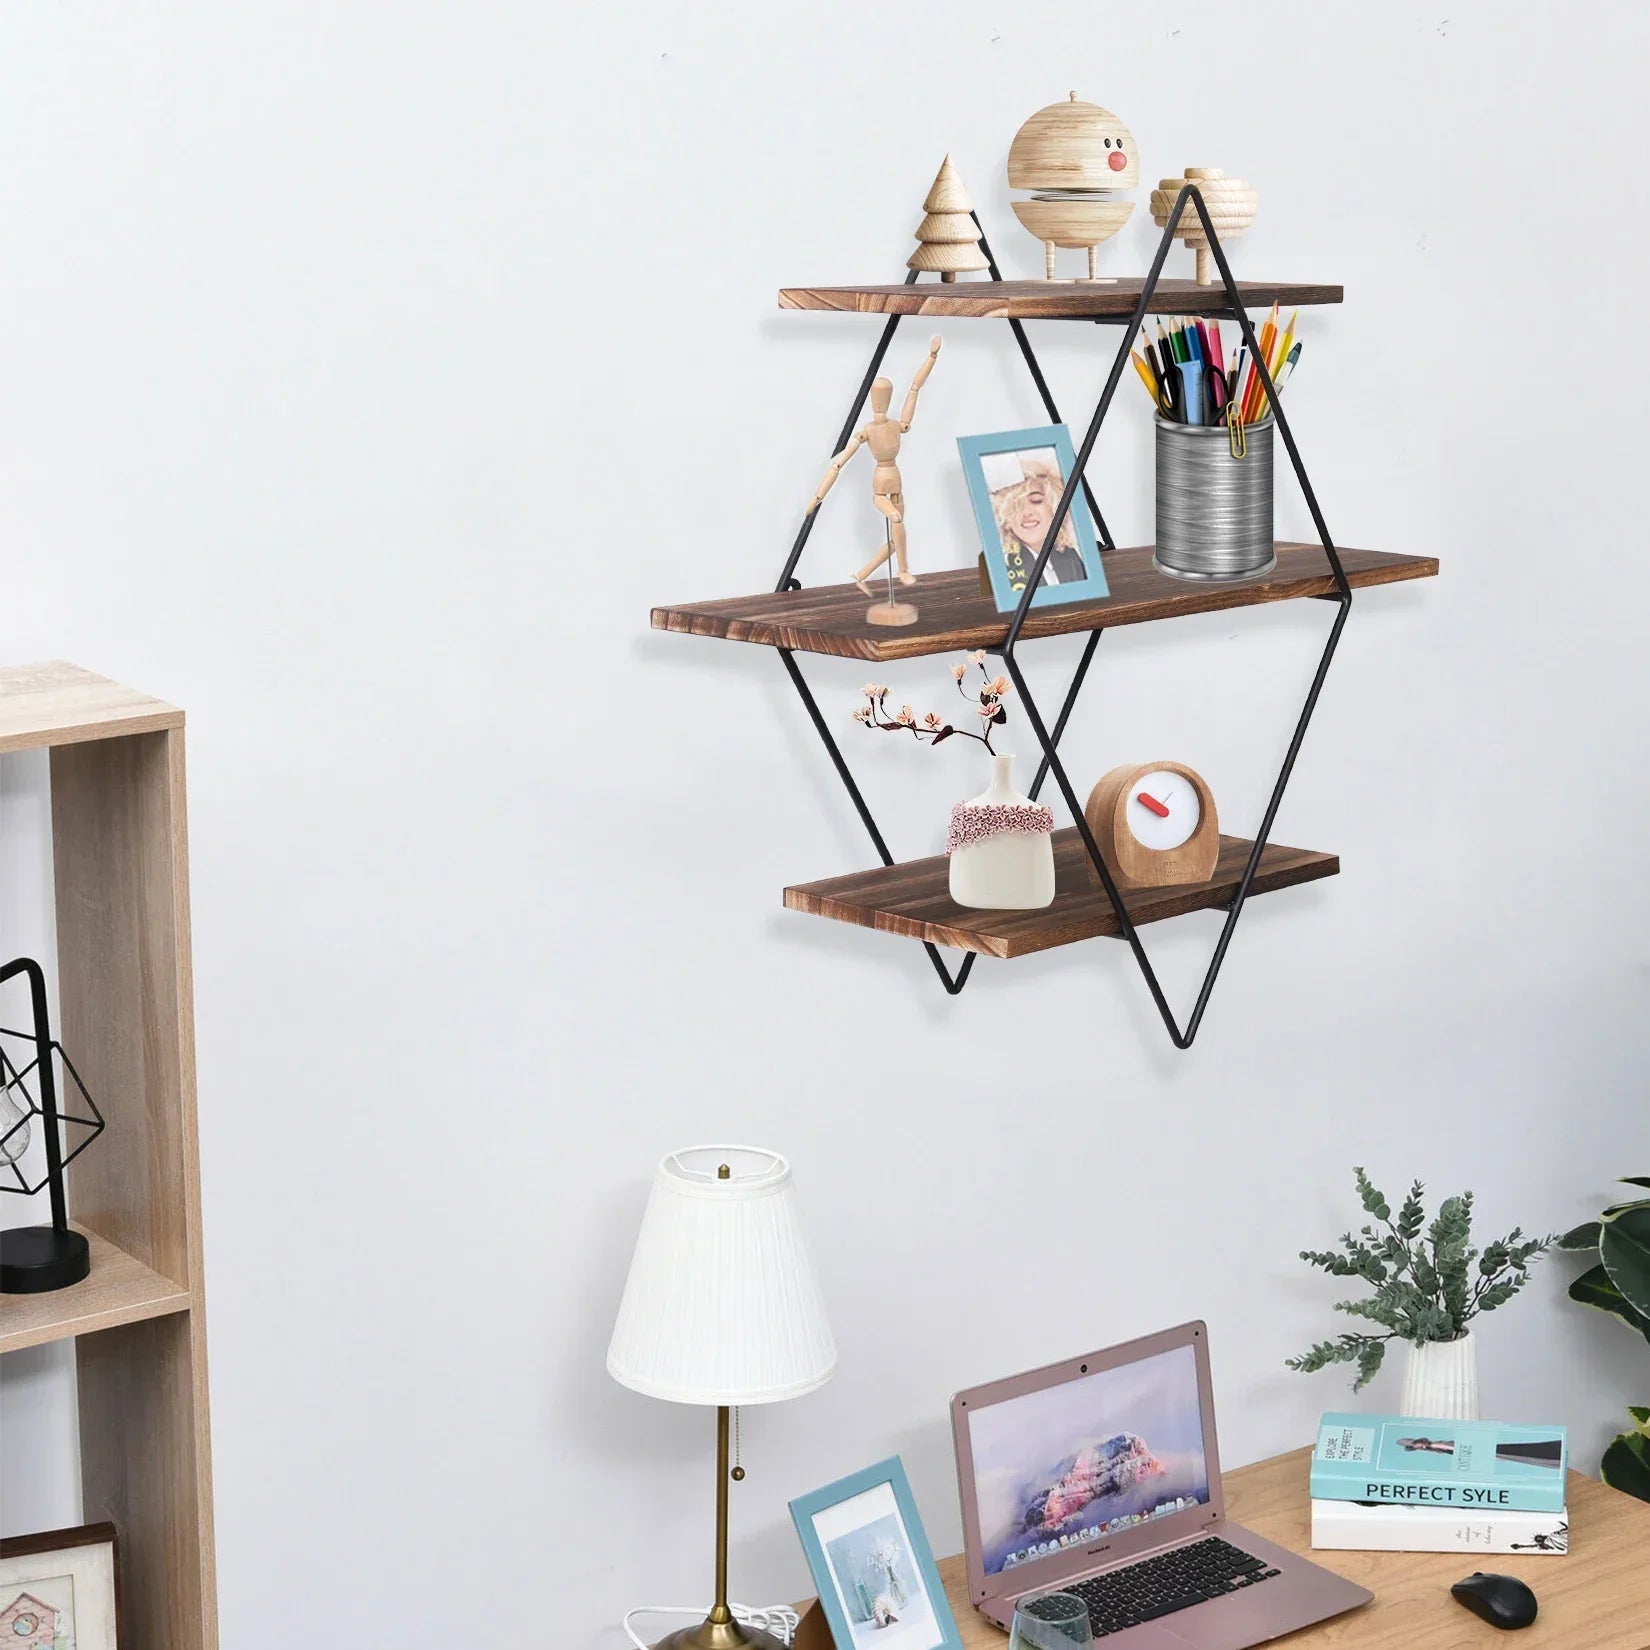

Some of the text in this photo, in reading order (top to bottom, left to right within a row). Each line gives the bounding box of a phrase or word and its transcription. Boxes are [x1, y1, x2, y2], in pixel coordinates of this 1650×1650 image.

[1325, 1437, 1338, 1459] EXPLORE
[1339, 1428, 1353, 1459] THE PERFECT
[1352, 1446, 1364, 1461] STYLE
[1366, 1483, 1510, 1504] PERFECT SYLE
